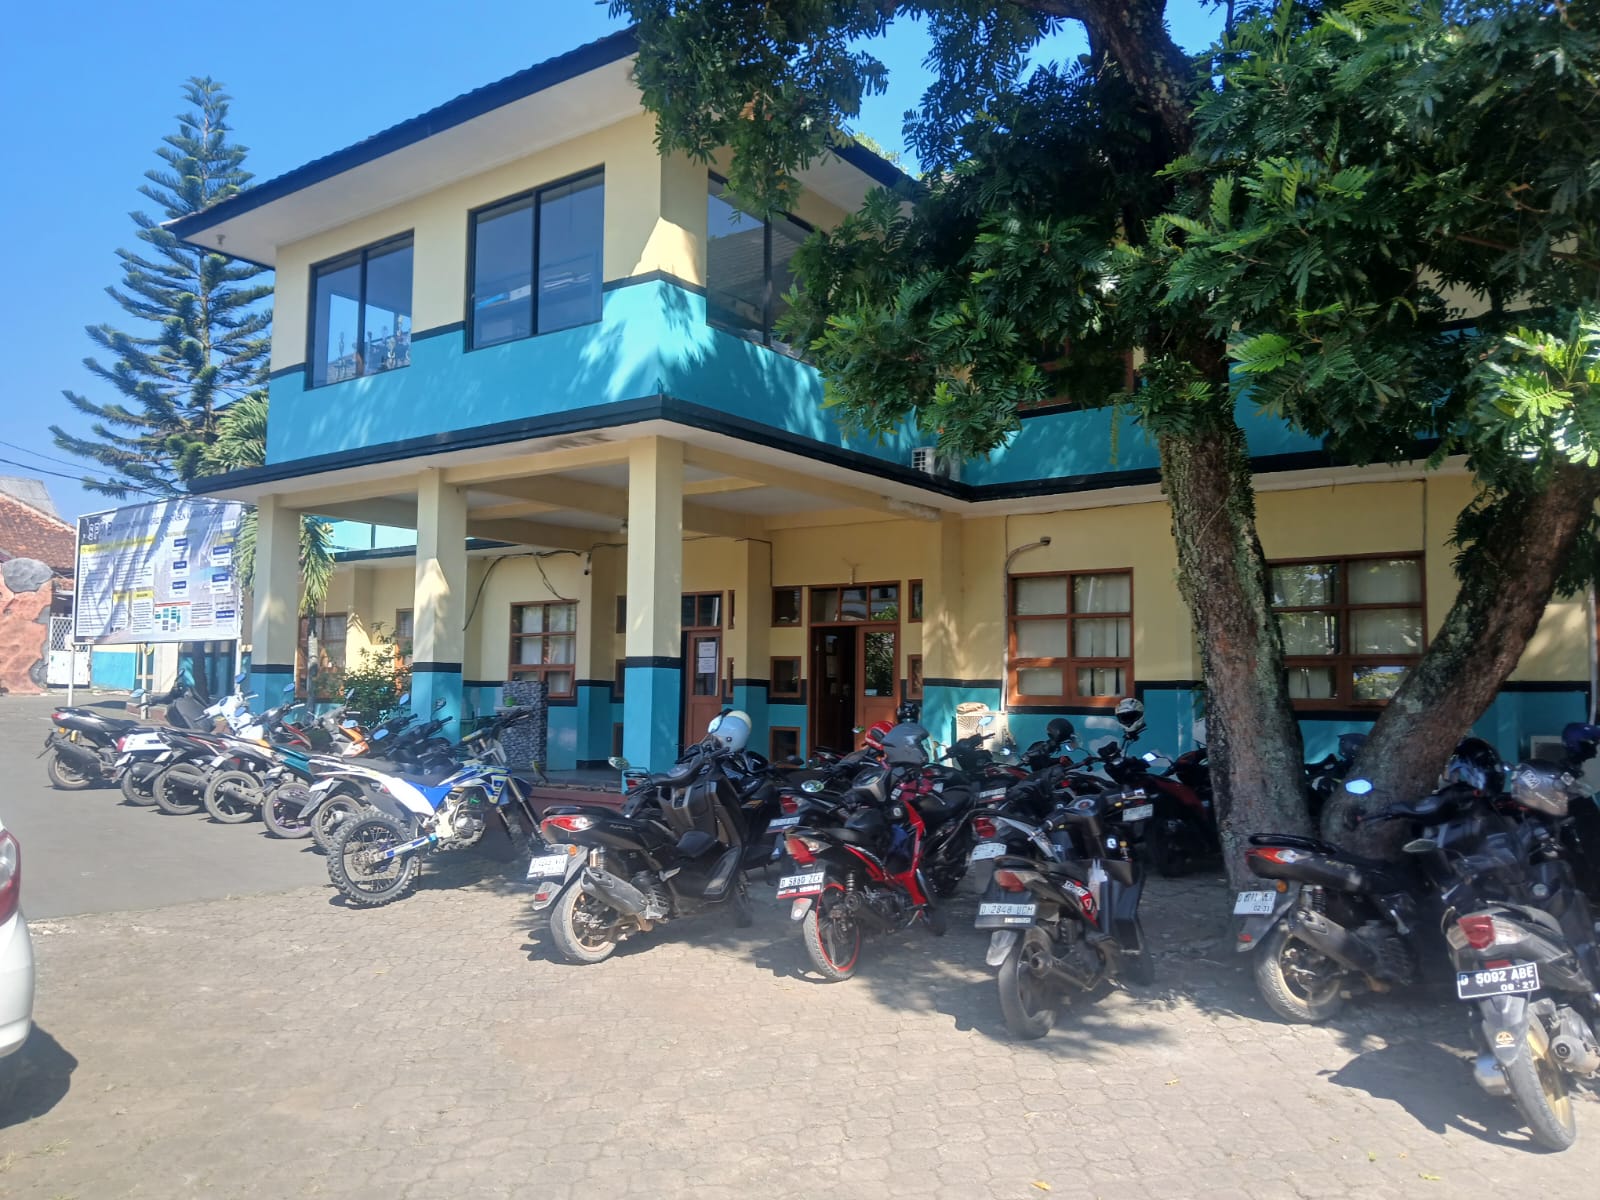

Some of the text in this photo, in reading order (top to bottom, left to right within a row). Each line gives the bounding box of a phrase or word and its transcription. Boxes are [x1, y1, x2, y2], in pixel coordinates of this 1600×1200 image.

[1460, 966, 1535, 986] D 5092 ABE
